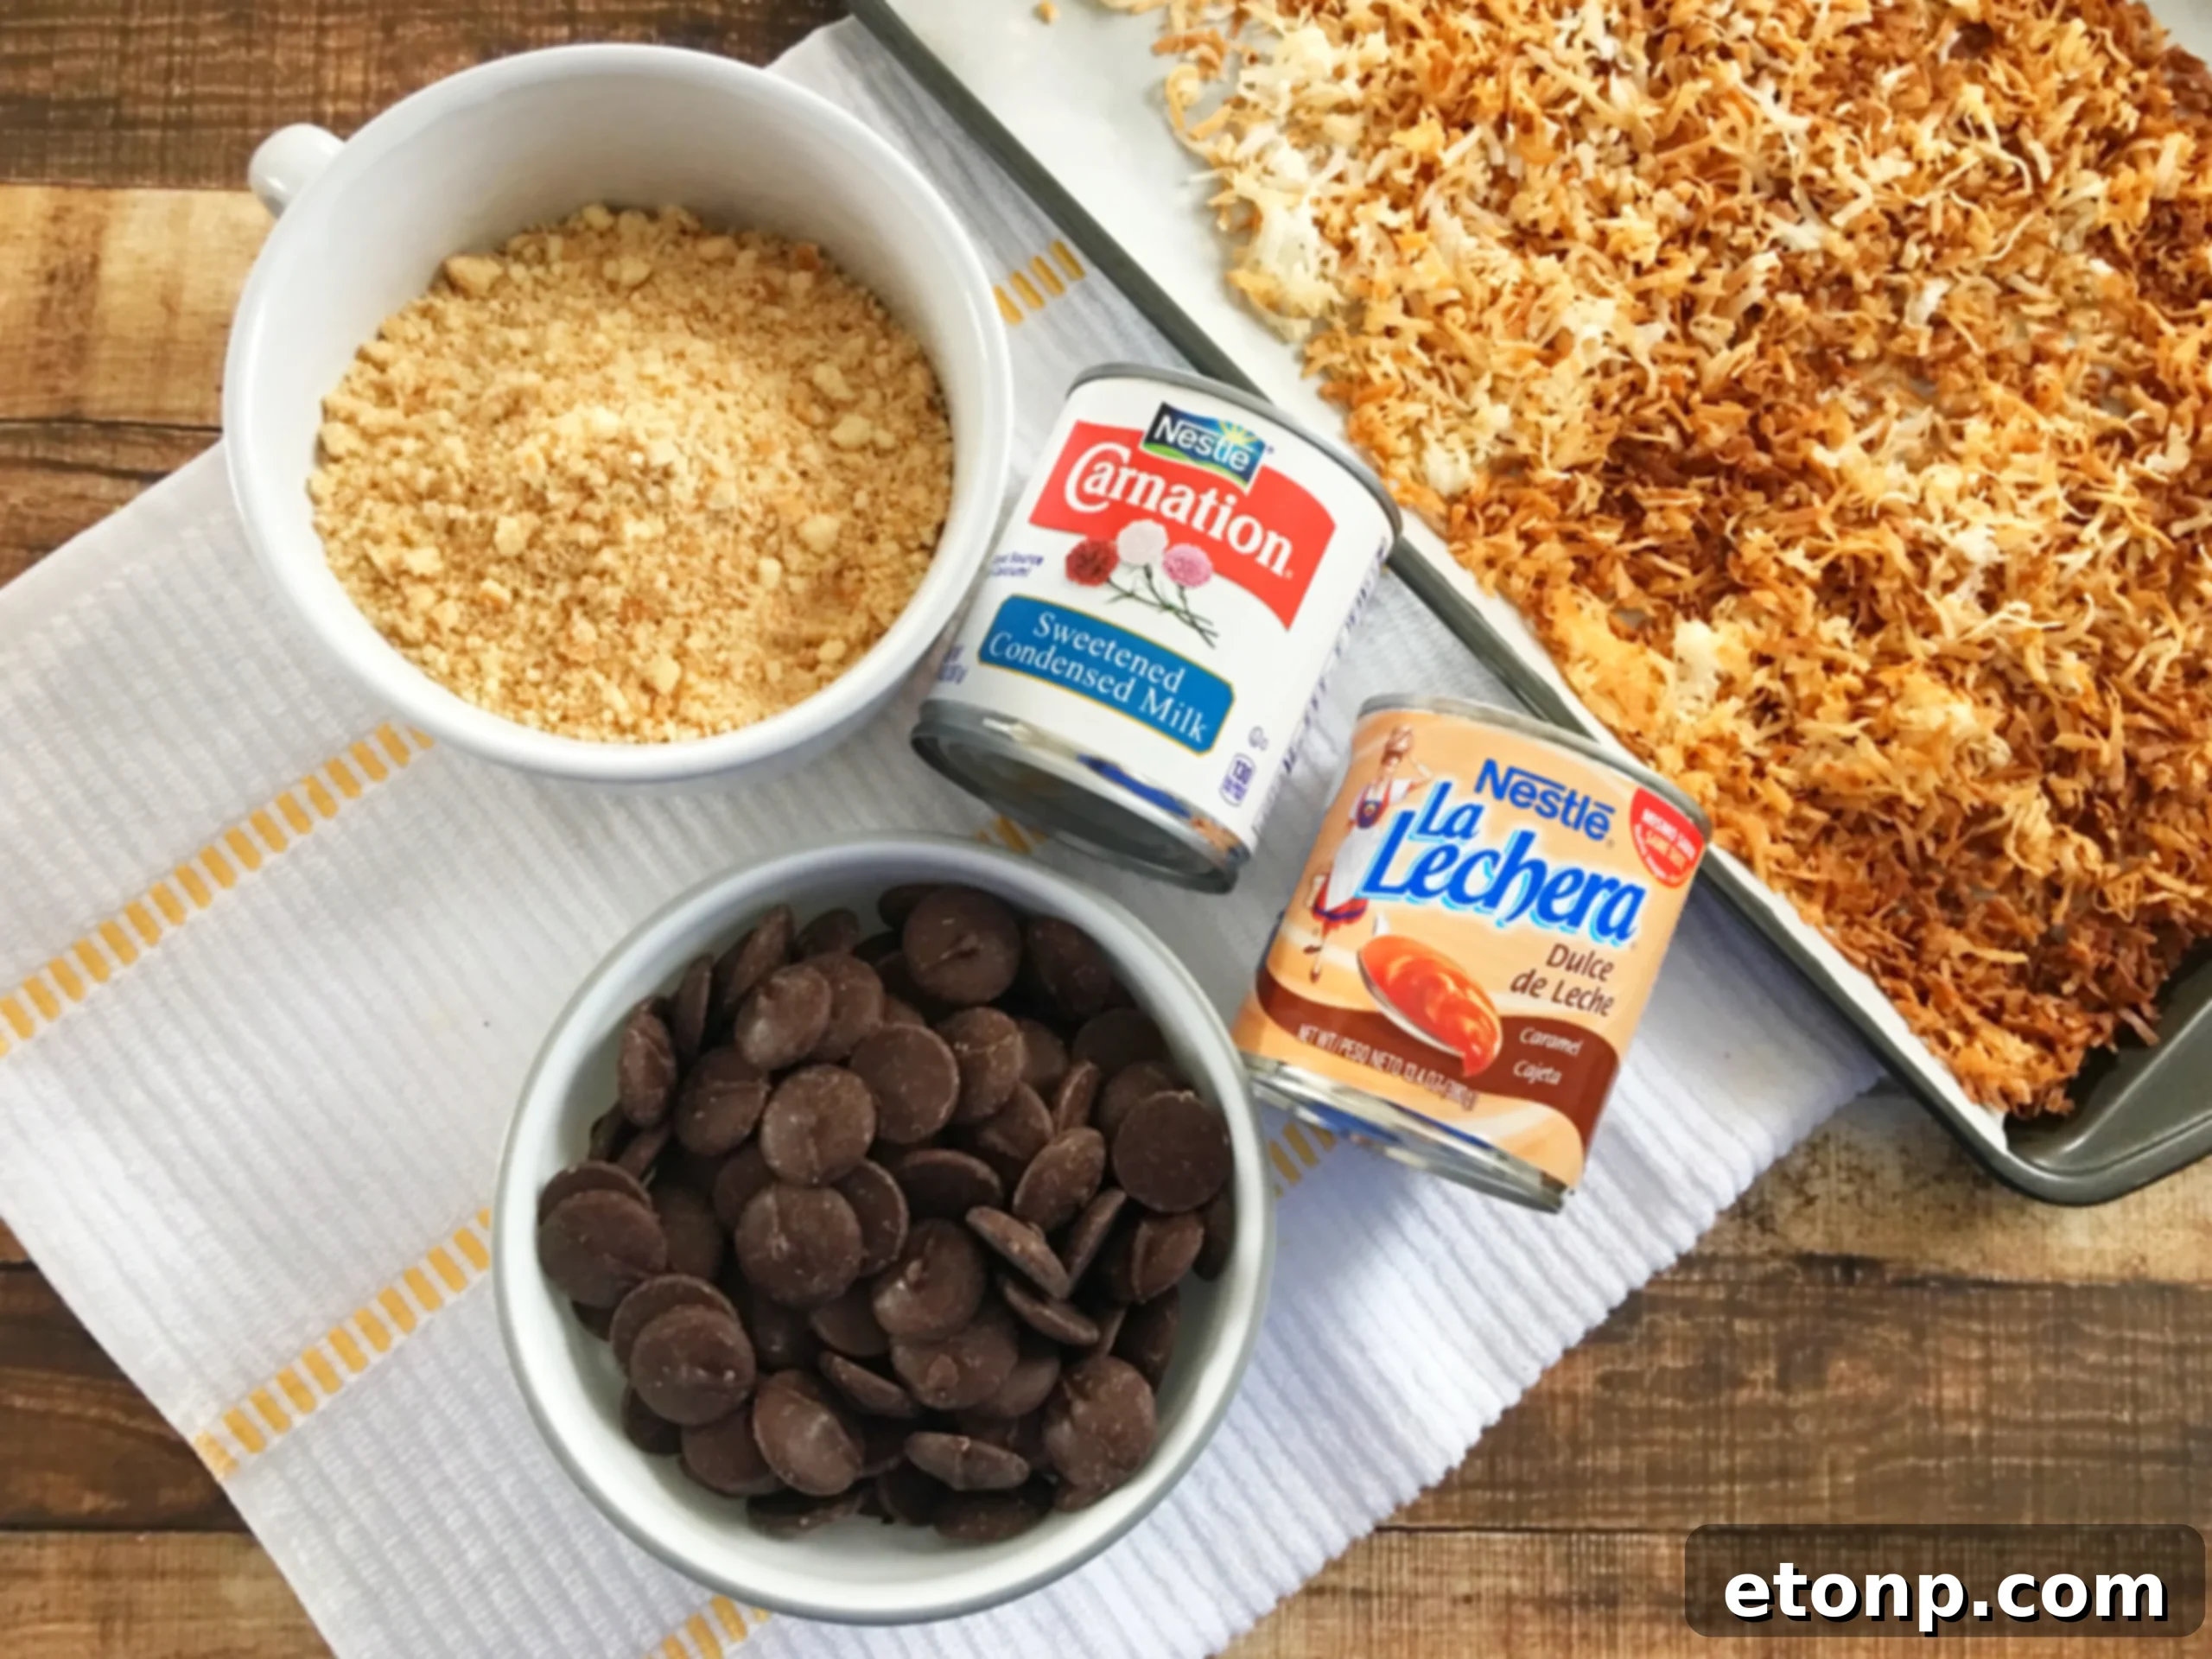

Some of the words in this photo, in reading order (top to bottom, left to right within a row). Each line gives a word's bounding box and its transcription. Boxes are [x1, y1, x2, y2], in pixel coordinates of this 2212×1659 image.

[1154, 415, 1252, 473] Nestlé
[1064, 442, 1293, 578] Carnation
[1033, 611, 1185, 693] Sweetened
[988, 632, 1135, 702] Condensed
[1139, 687, 1208, 742] Milk
[1410, 780, 1485, 843] La
[1474, 759, 1616, 841] Nestlé
[1356, 809, 1647, 944] Lechera
[1546, 943, 1614, 982] Dulce
[1510, 969, 1547, 999] de
[1550, 979, 1615, 1018] Leche
[1371, 1048, 1403, 1076] NETO
[1518, 1026, 1584, 1057] Caramel
[1512, 1059, 1563, 1087] Cajeta
